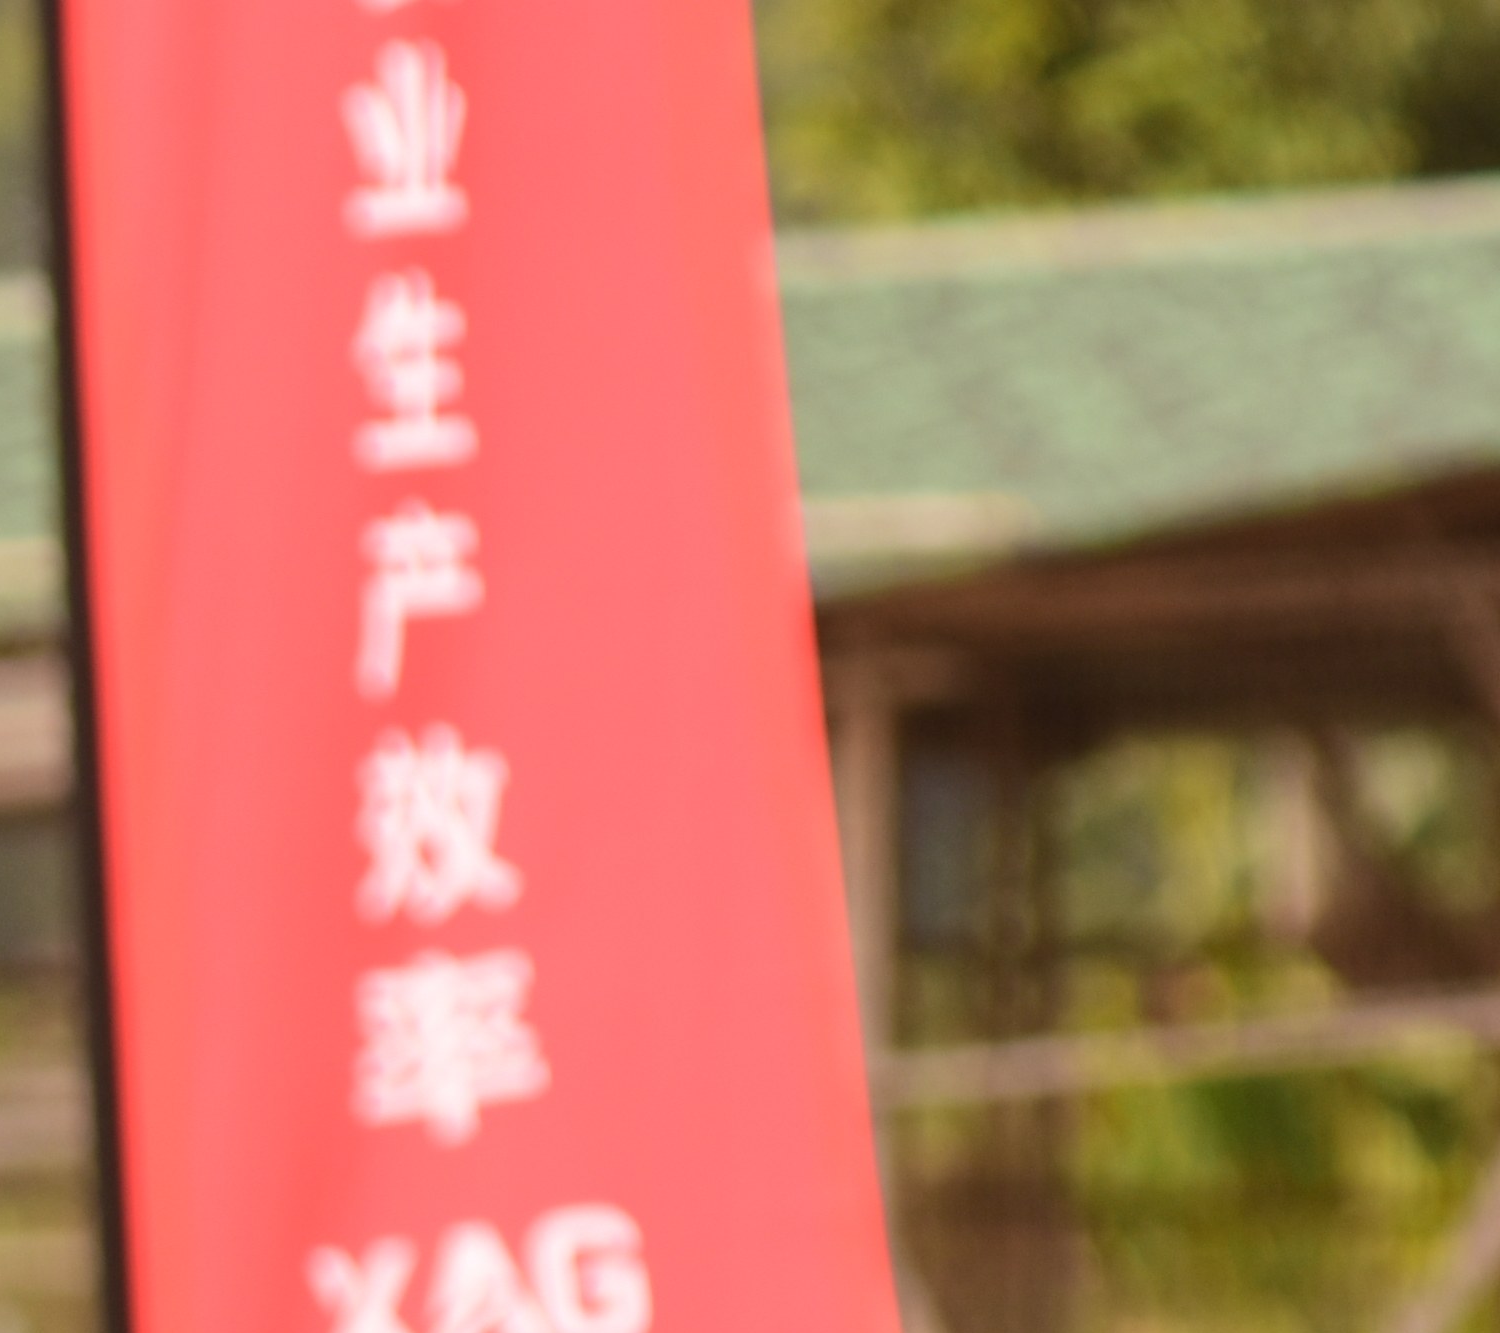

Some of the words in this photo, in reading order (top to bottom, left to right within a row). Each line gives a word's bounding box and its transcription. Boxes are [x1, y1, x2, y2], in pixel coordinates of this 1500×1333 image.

[340, 0, 550, 1146] 业生产效率
